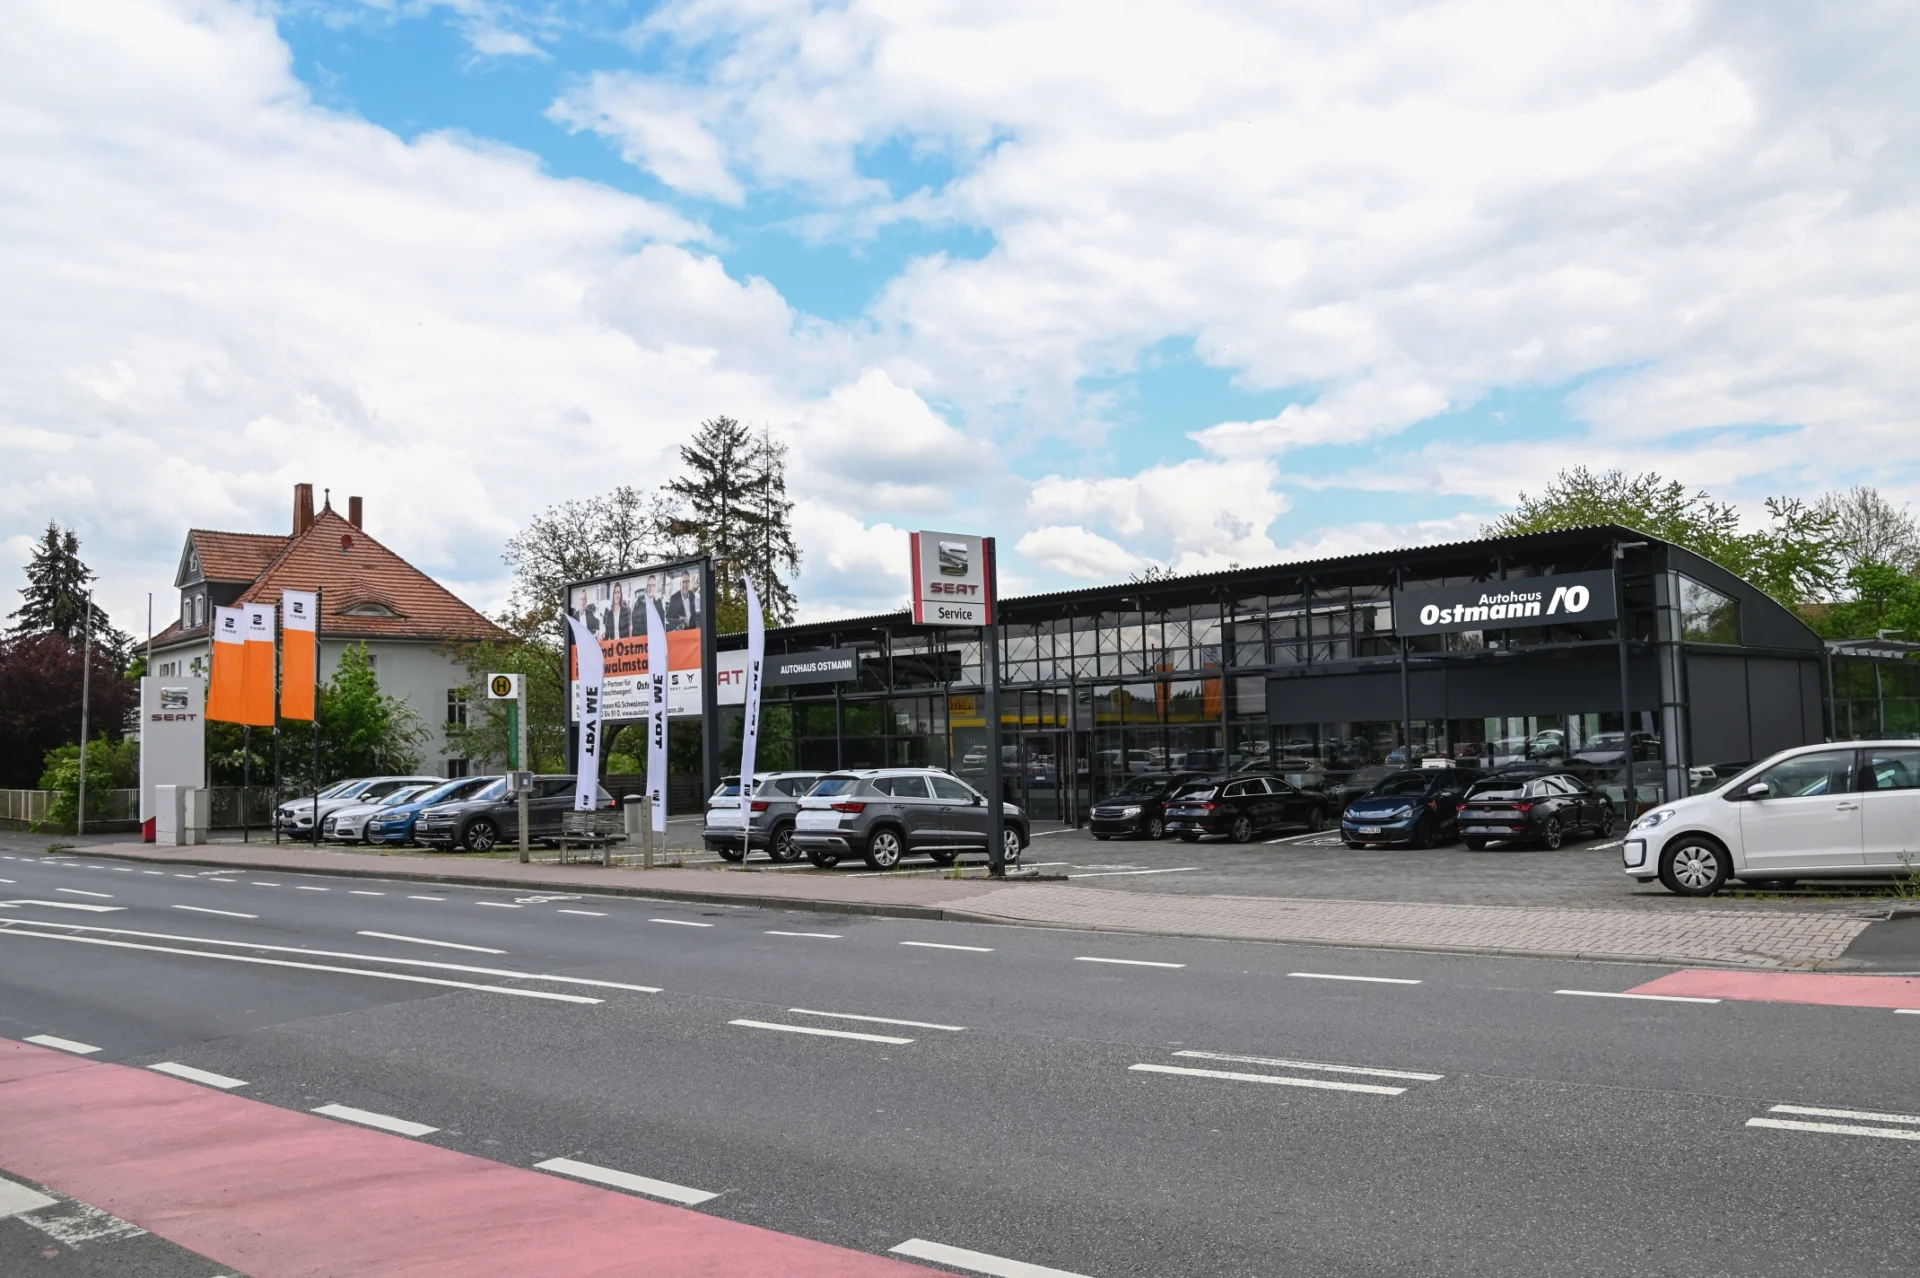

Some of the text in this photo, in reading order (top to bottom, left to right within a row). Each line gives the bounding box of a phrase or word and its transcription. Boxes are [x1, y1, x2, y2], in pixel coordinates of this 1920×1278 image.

[930, 582, 979, 595] SEAT
[1478, 591, 1542, 605] Autohaus
[938, 607, 973, 620] Service
[1420, 601, 1541, 625] Ostmann
[602, 642, 648, 658] nd Ostm
[604, 658, 648, 673] walmsta
[780, 659, 852, 675] AUTOHAUS OSTMANN
[717, 669, 744, 686] AT
[622, 700, 649, 708] Schwalmsta
[151, 713, 198, 722] SEAT
